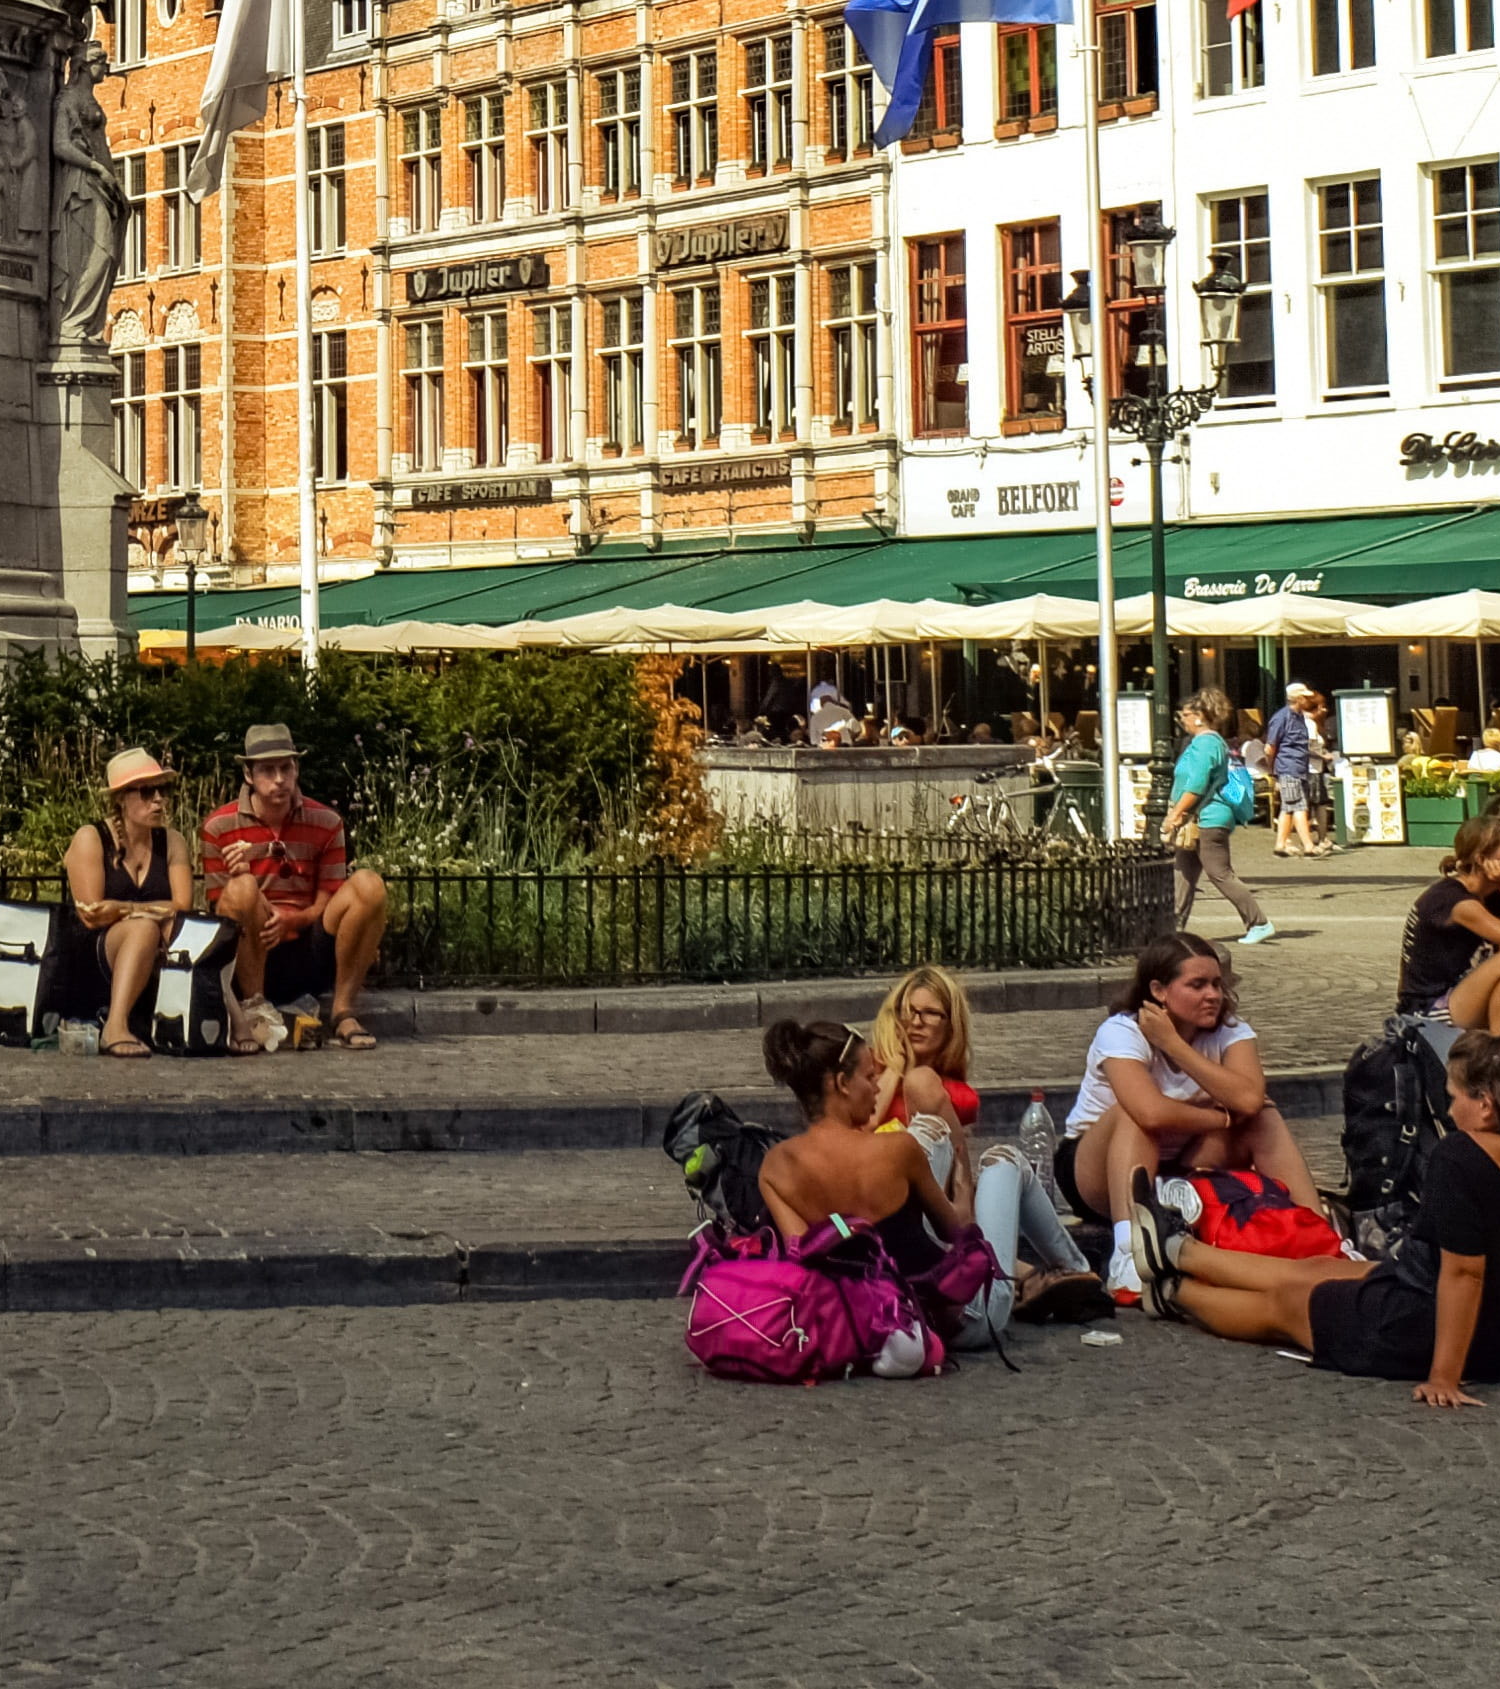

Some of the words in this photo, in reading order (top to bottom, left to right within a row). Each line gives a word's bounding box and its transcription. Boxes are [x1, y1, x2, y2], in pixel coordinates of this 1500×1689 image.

[677, 223, 766, 261] Jupiler
[437, 262, 511, 297] Jupiler
[1026, 327, 1064, 342] STELLA
[661, 467, 700, 486] CAFE
[418, 485, 452, 502] CAFE
[947, 488, 980, 503] GRAND
[997, 481, 1080, 516] BELFORT
[951, 504, 976, 518] CAFE
[1185, 577, 1247, 598] Brasserie
[1255, 574, 1277, 594] De
[258, 615, 300, 630] MARIO
